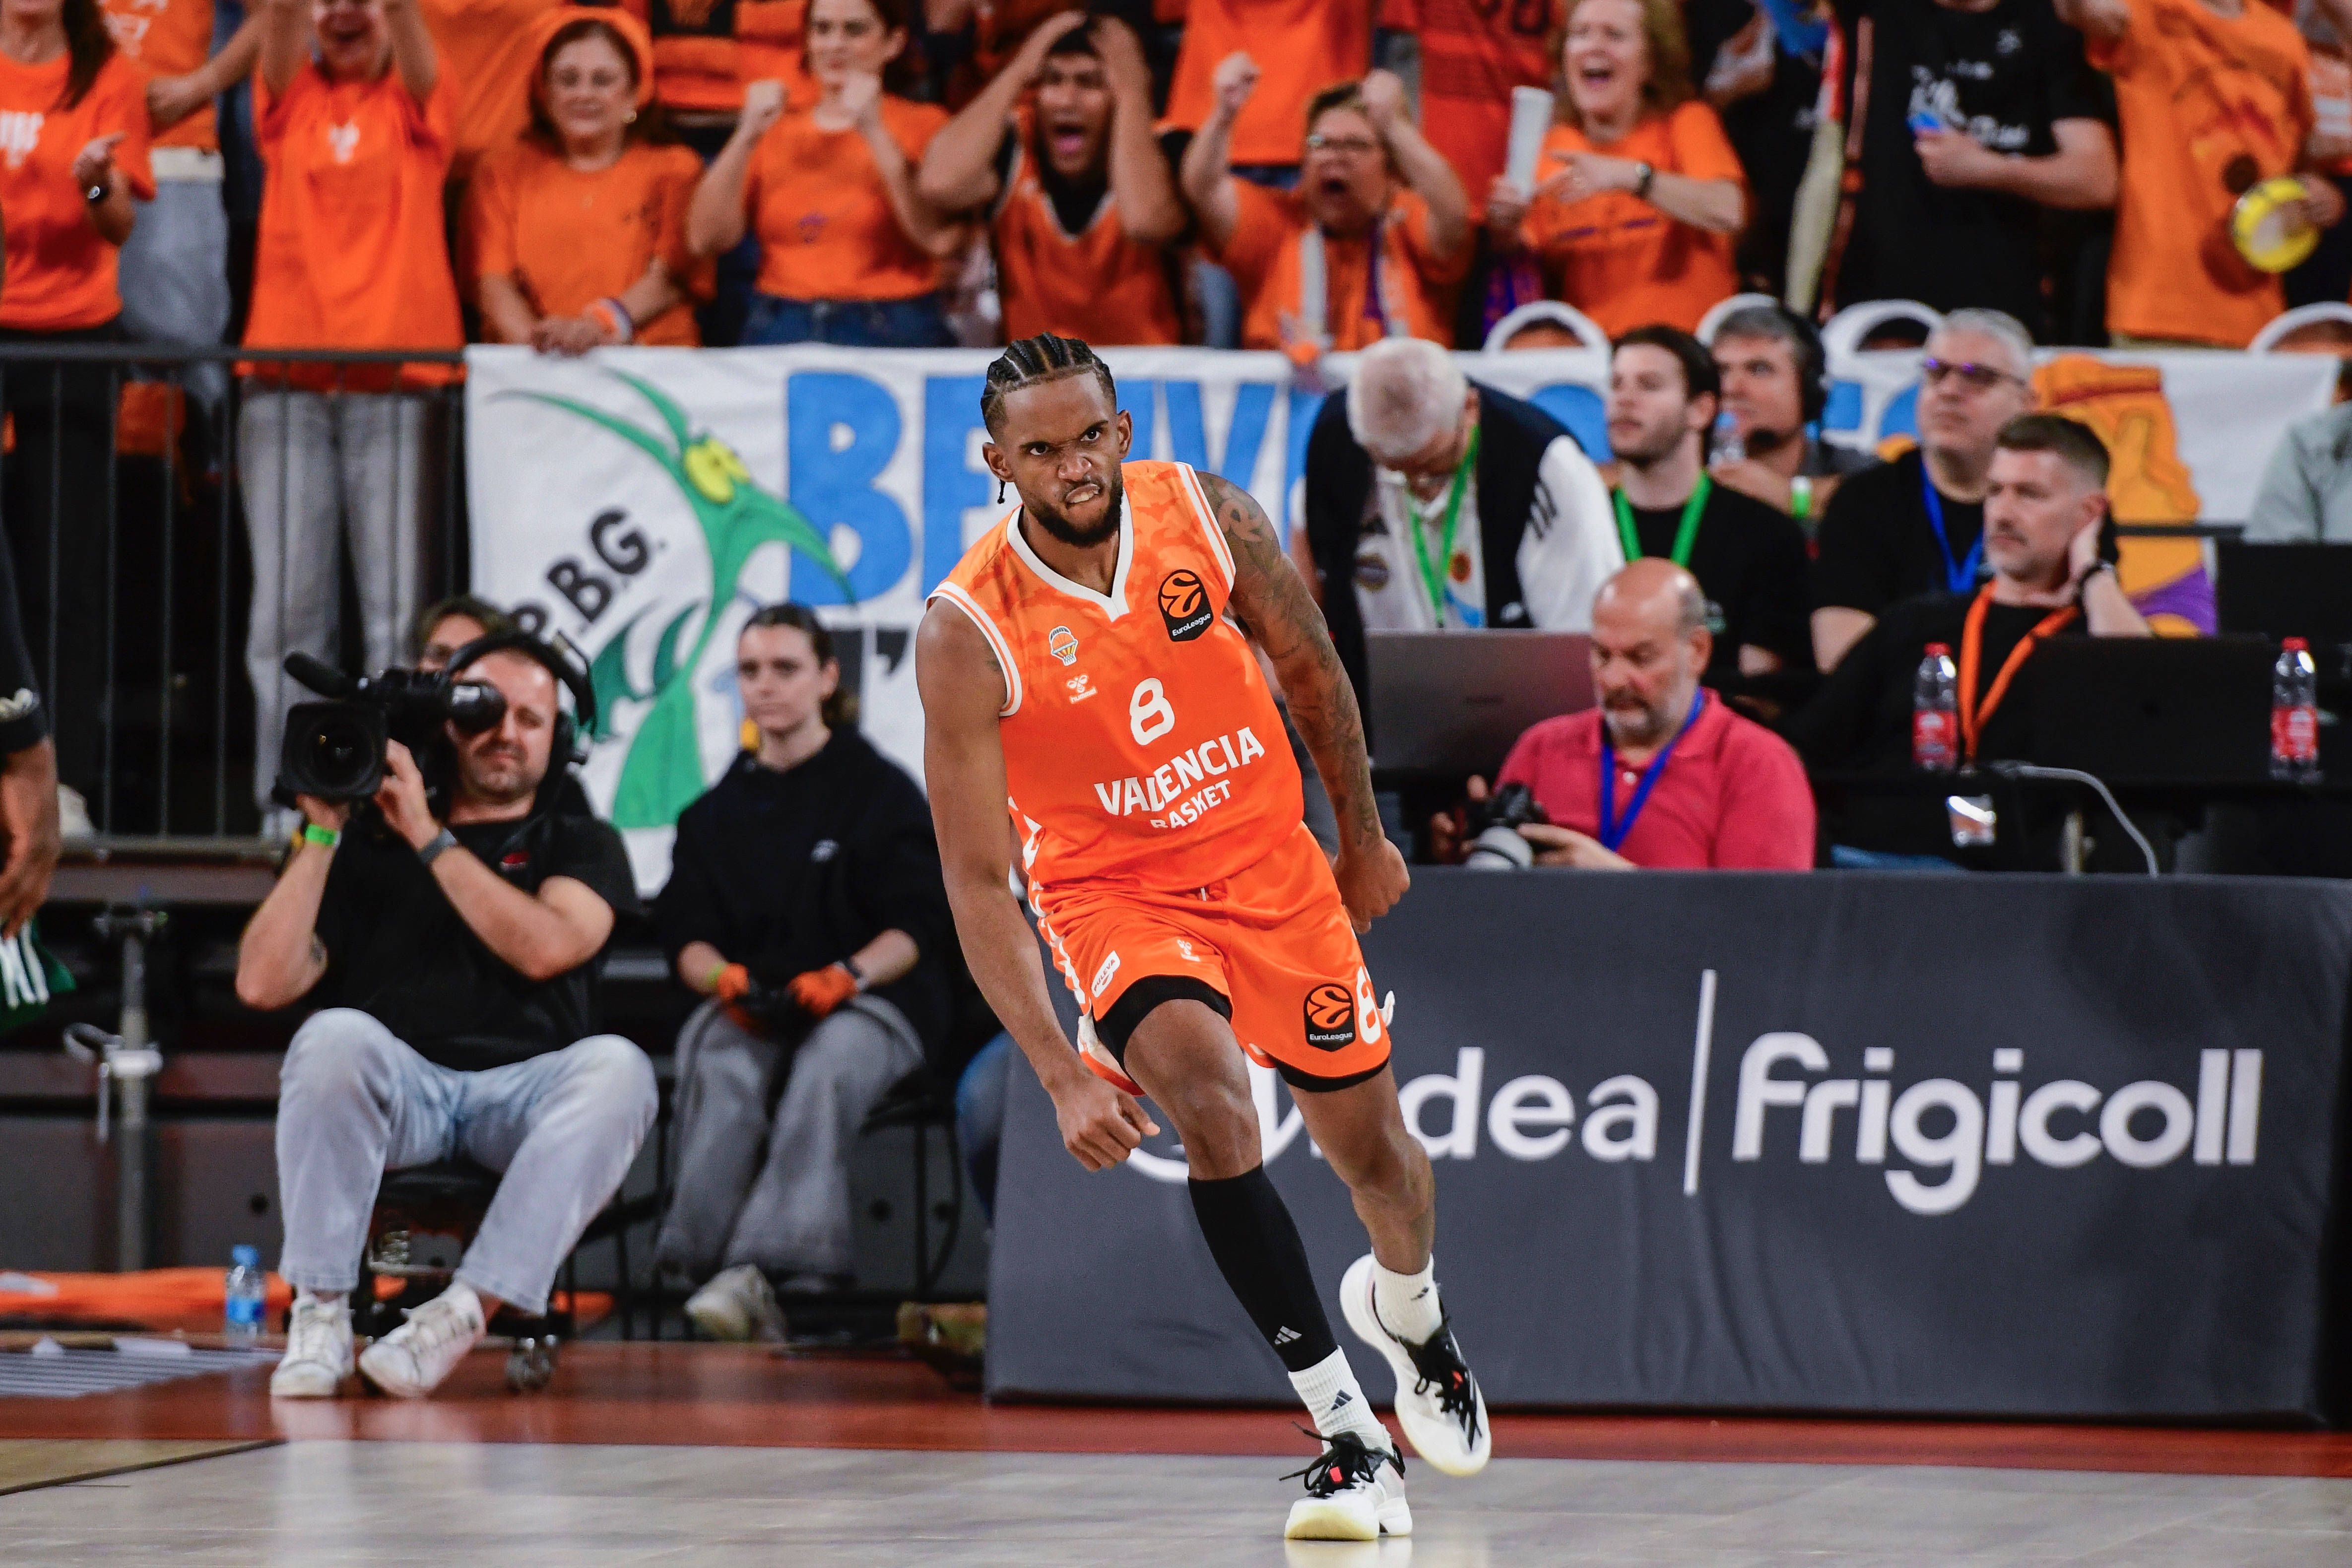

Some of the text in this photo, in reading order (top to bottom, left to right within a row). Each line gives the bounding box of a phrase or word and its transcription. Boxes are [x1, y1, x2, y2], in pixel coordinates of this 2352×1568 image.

[1172, 613, 1211, 636] EuroLeague
[1129, 677, 1176, 746] 8
[1094, 726, 1265, 816] VALENCIA
[1150, 779, 1231, 828] BASKET
[1093, 958, 1116, 992] PULEVA
[1356, 965, 1381, 1045] 8
[1309, 1031, 1353, 1041] EuroLeague
[1732, 1031, 2263, 1216] frigicoll
